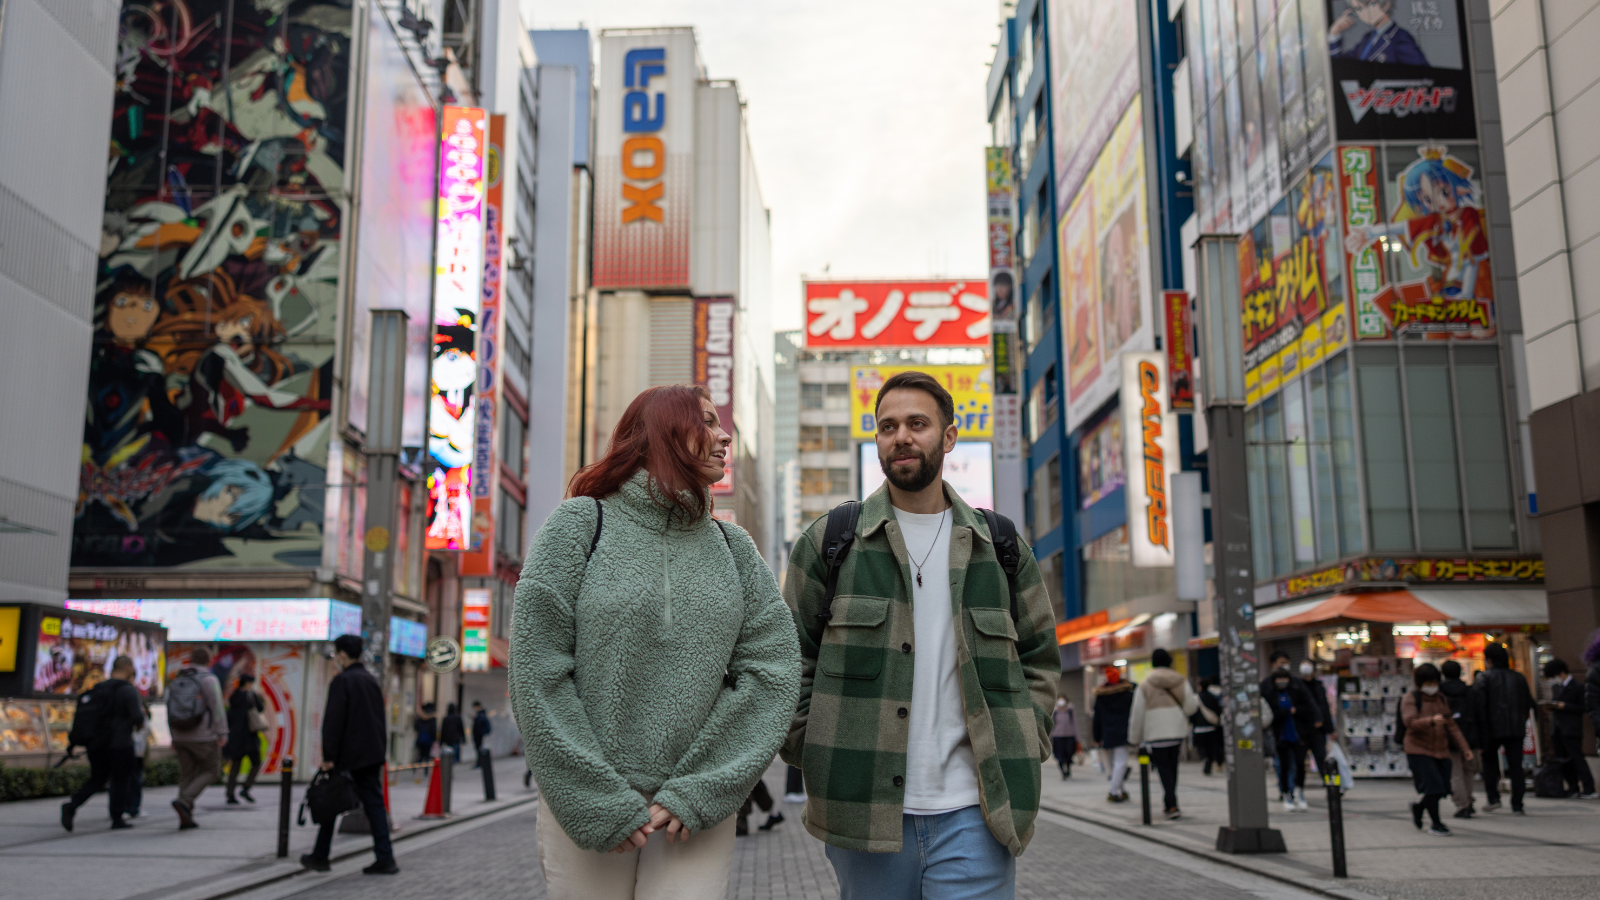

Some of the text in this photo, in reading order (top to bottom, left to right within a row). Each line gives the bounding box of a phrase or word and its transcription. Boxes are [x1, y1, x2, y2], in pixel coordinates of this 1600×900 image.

[705, 302, 732, 406] Duty Free
[1139, 361, 1170, 554] GAMERS
